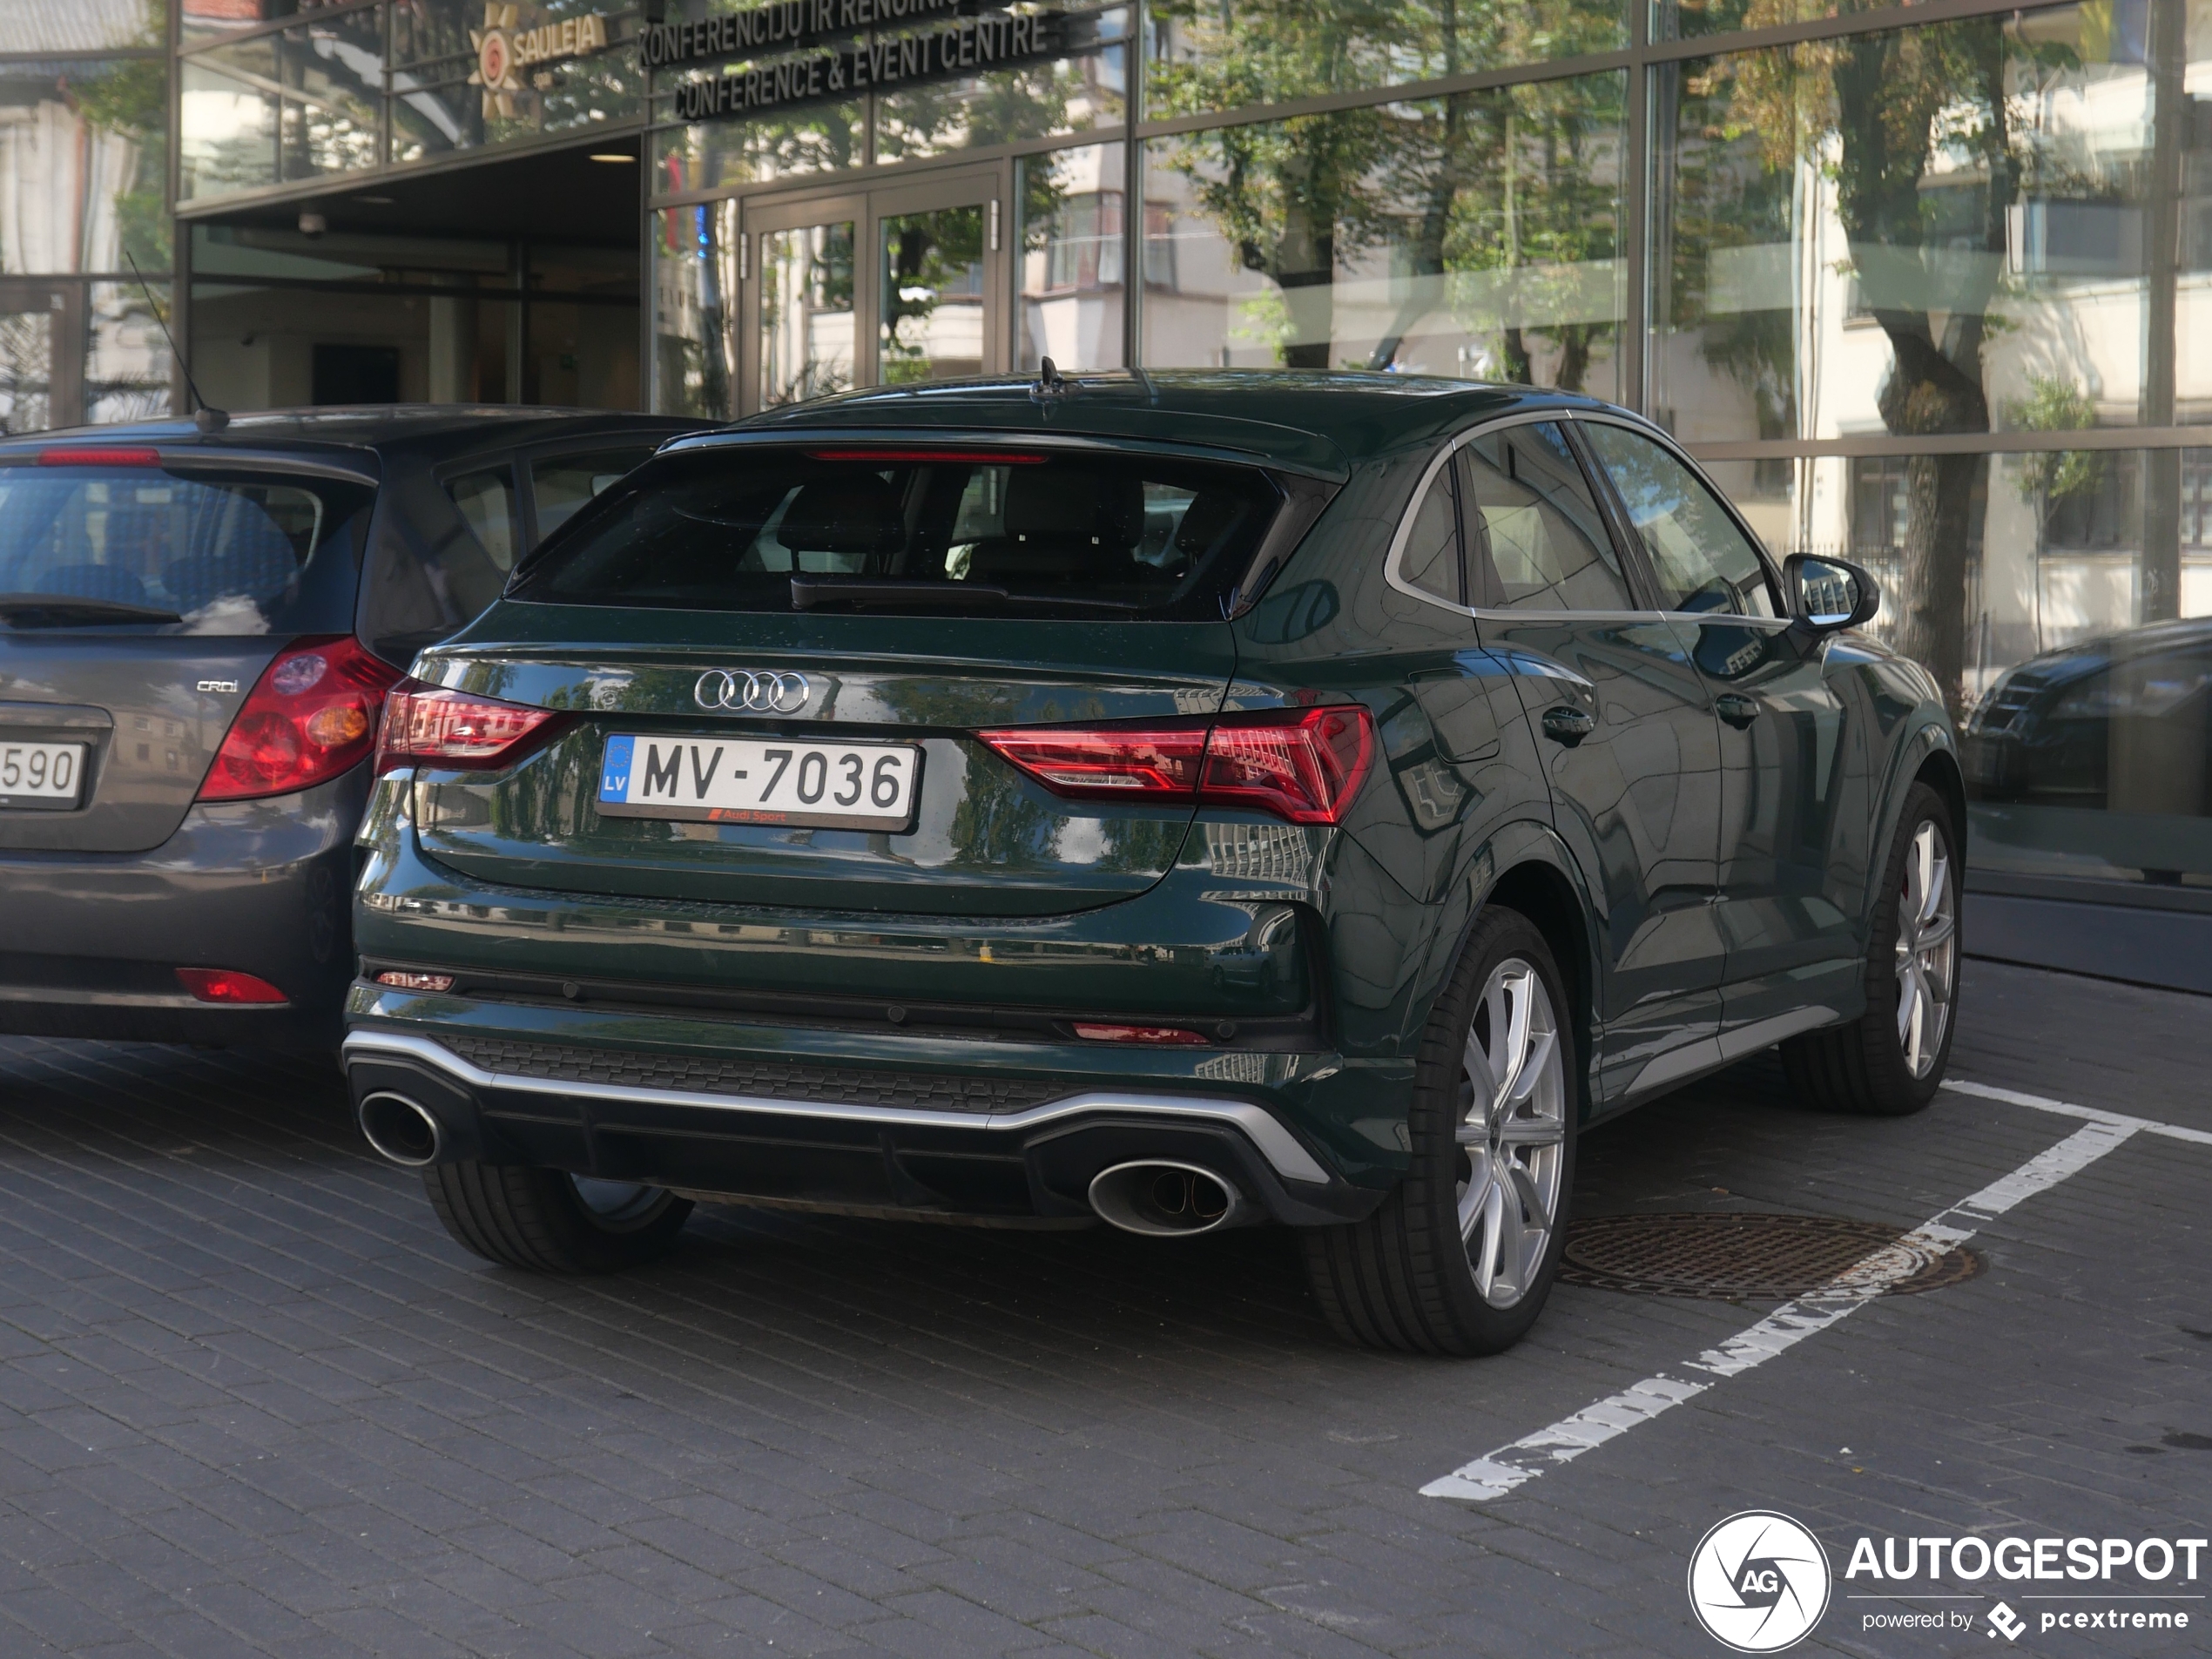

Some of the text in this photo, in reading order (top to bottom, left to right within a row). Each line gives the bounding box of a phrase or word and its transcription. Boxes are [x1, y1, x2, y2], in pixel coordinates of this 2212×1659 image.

[810, 0, 833, 33] IR
[512, 14, 599, 66] SAULEJA
[673, 57, 821, 119] CONFERENCE
[827, 52, 845, 90] &
[853, 32, 934, 86] EVENT
[941, 13, 1047, 70] CENTRE
[604, 775, 626, 792] LV
[642, 744, 901, 808] MV-7036
[723, 809, 786, 822] Audi Sport
